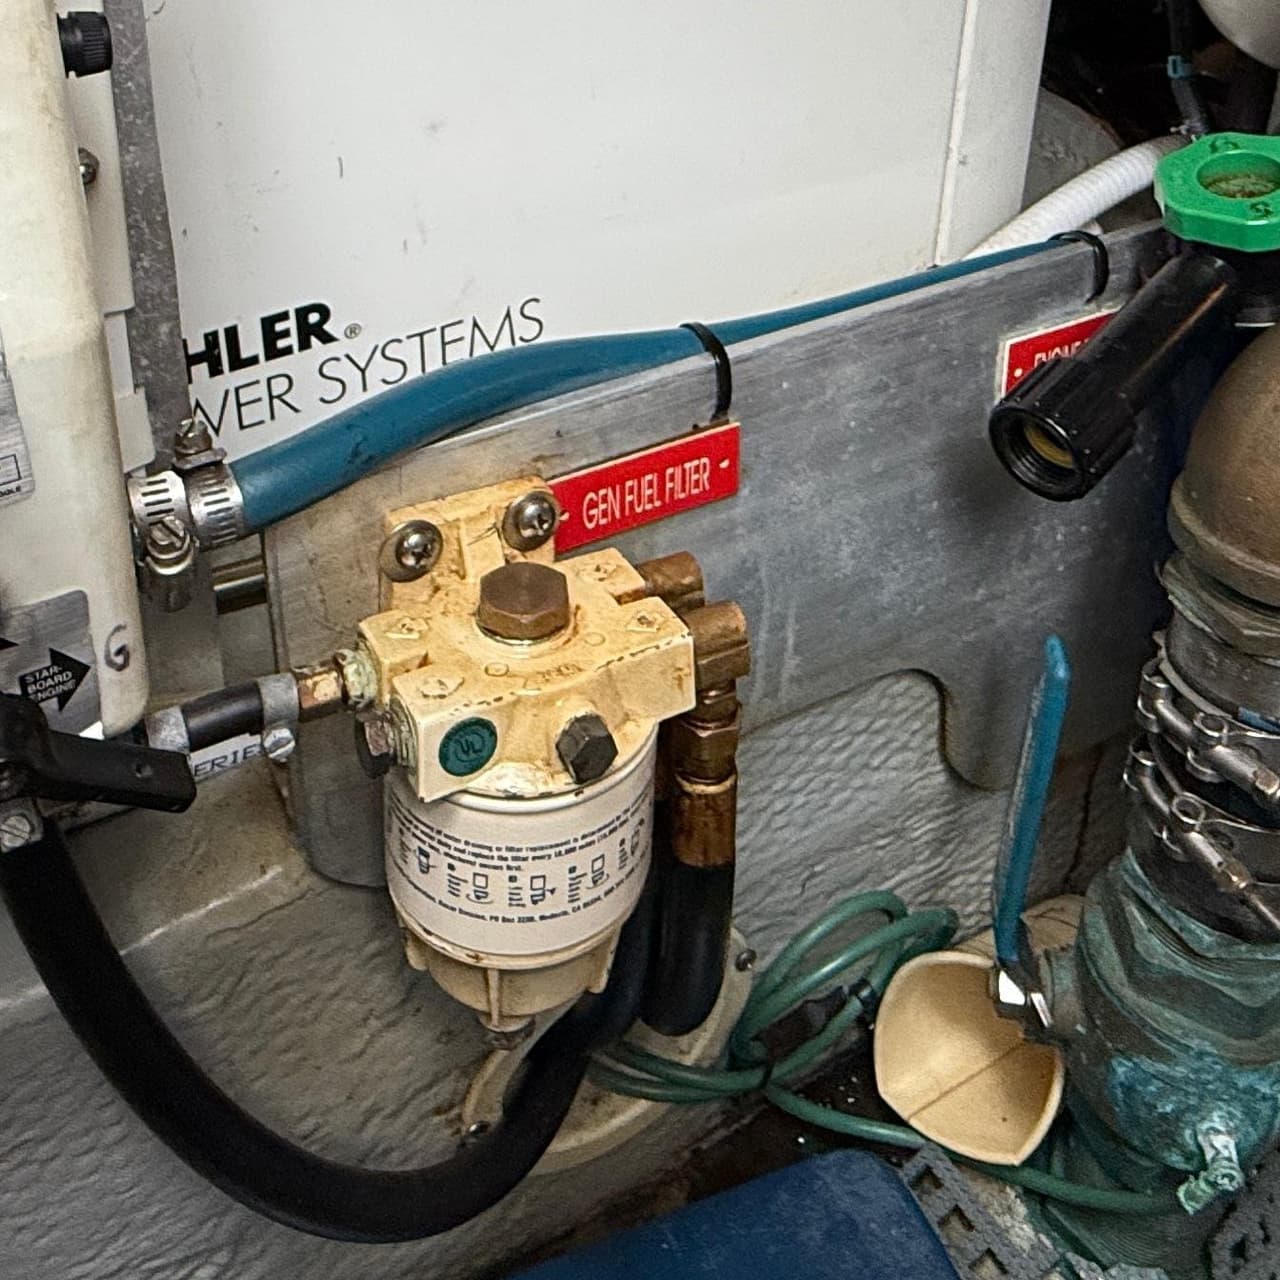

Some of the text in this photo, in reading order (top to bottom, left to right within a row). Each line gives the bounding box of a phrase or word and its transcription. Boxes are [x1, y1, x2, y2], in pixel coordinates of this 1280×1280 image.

[182, 302, 340, 385] HLER
[318, 297, 545, 404] SYSTEMS
[582, 456, 710, 530] GEN FUEL FILTER
[27, 671, 73, 694] BOARD
[193, 742, 261, 777] ERIE
